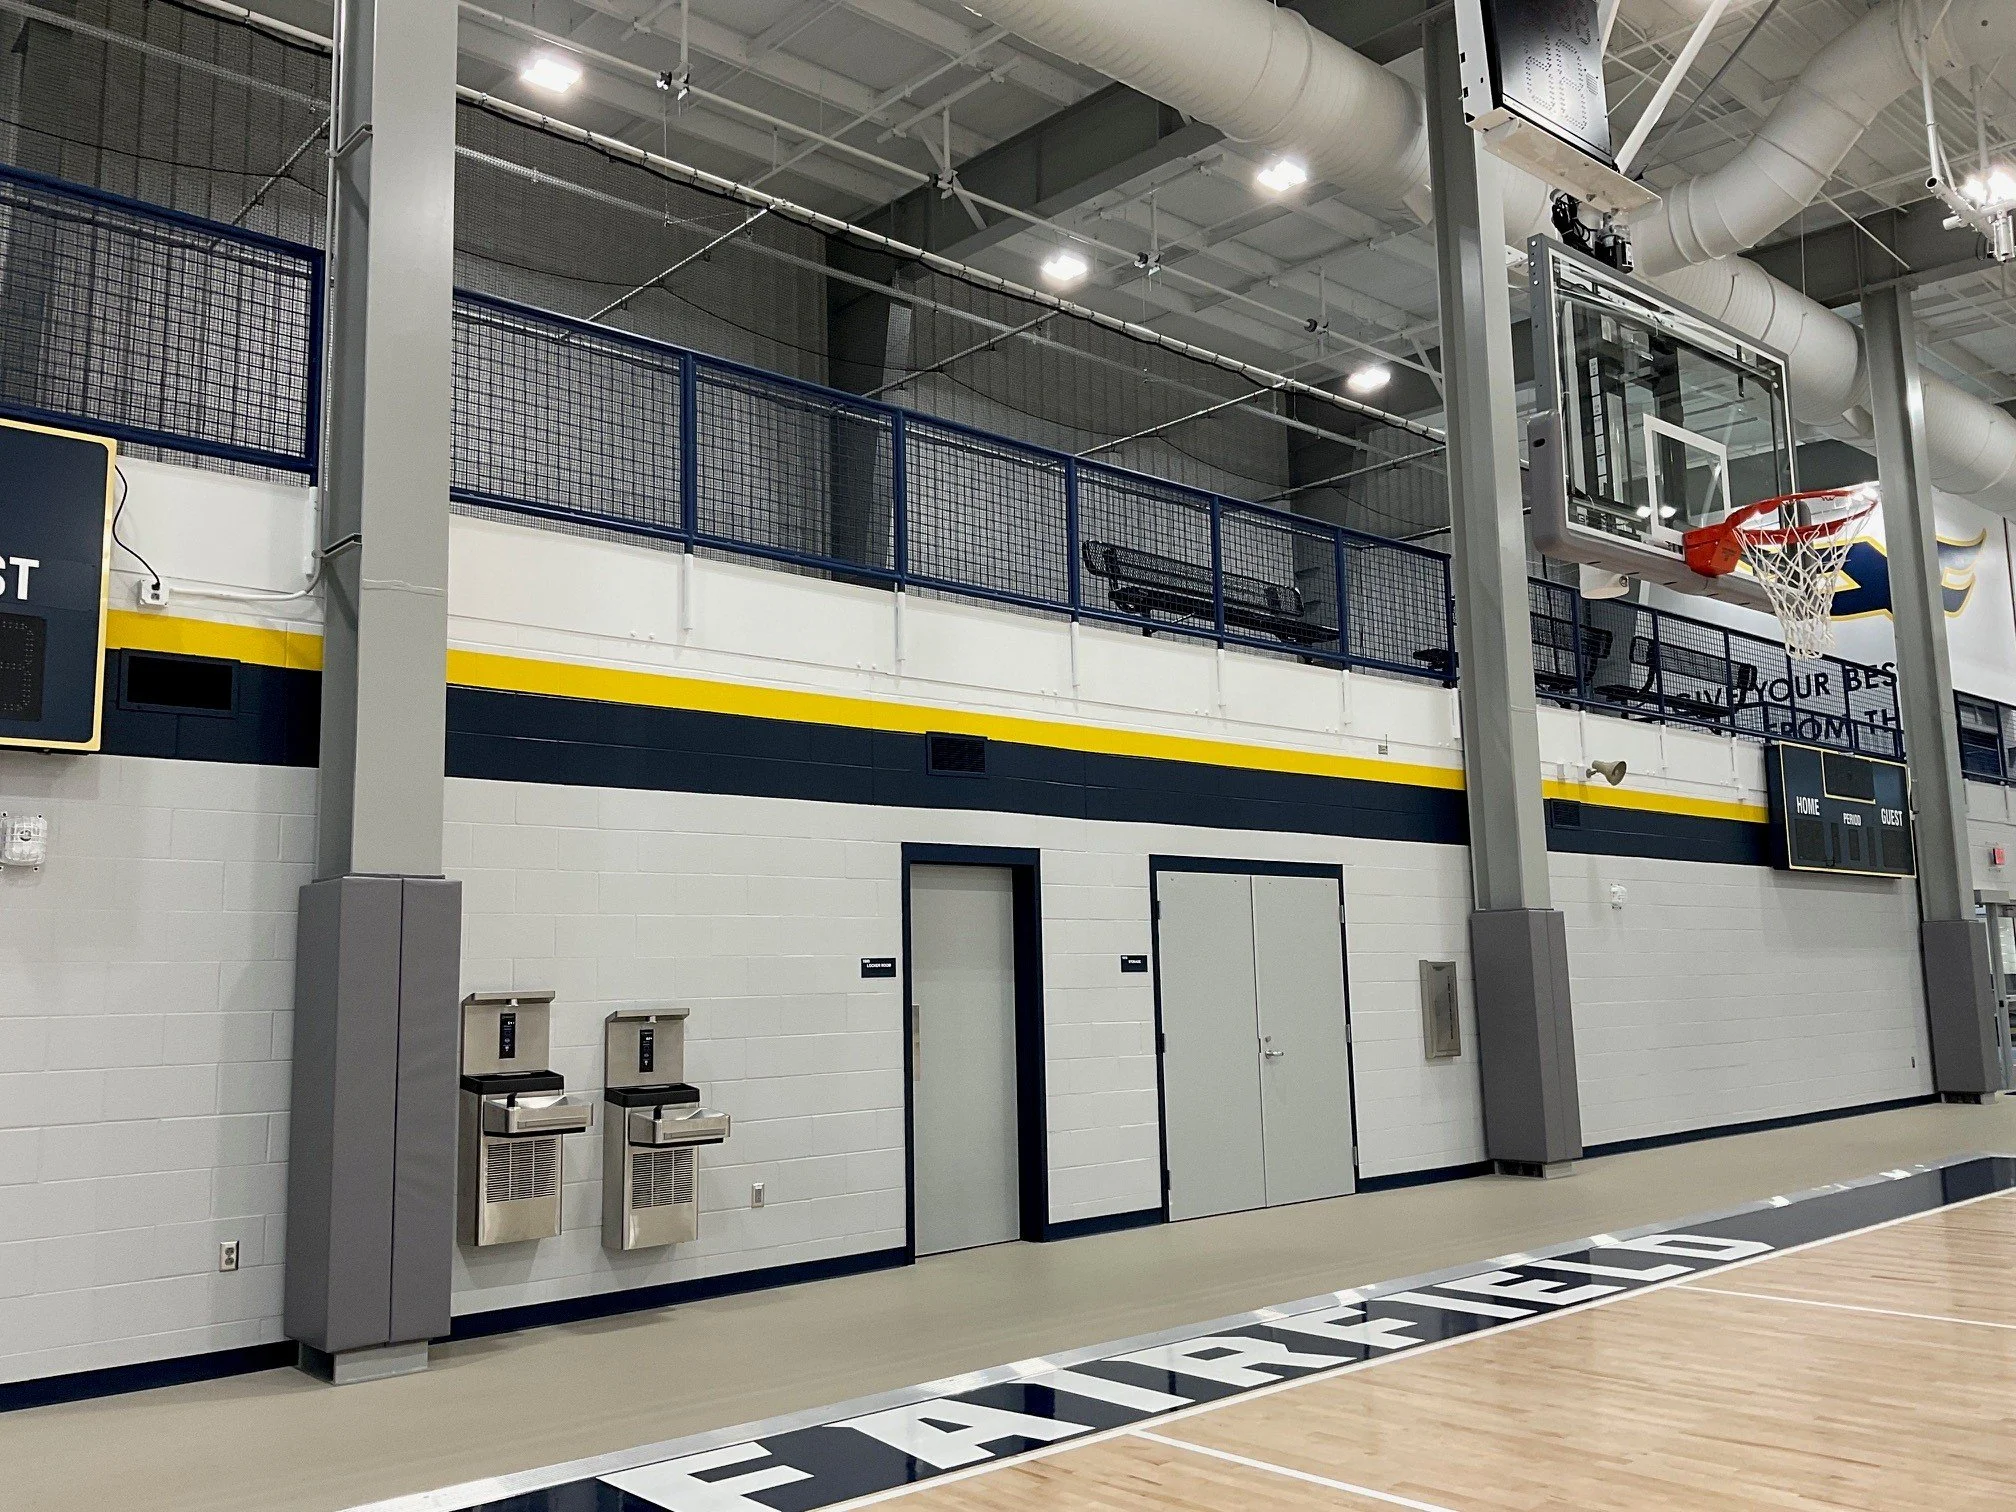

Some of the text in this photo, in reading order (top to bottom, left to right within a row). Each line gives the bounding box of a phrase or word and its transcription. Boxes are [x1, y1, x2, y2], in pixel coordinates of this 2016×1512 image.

[0, 556, 40, 600] T
[1754, 672, 1831, 702] YOUR
[1846, 662, 1898, 692] BES
[1865, 709, 1900, 735] TH
[1796, 796, 1821, 816] HOME
[1880, 808, 1903, 827] GUEST
[1842, 812, 1862, 827] PERIOD
[596, 1233, 1776, 1512] FAIRFIELD
